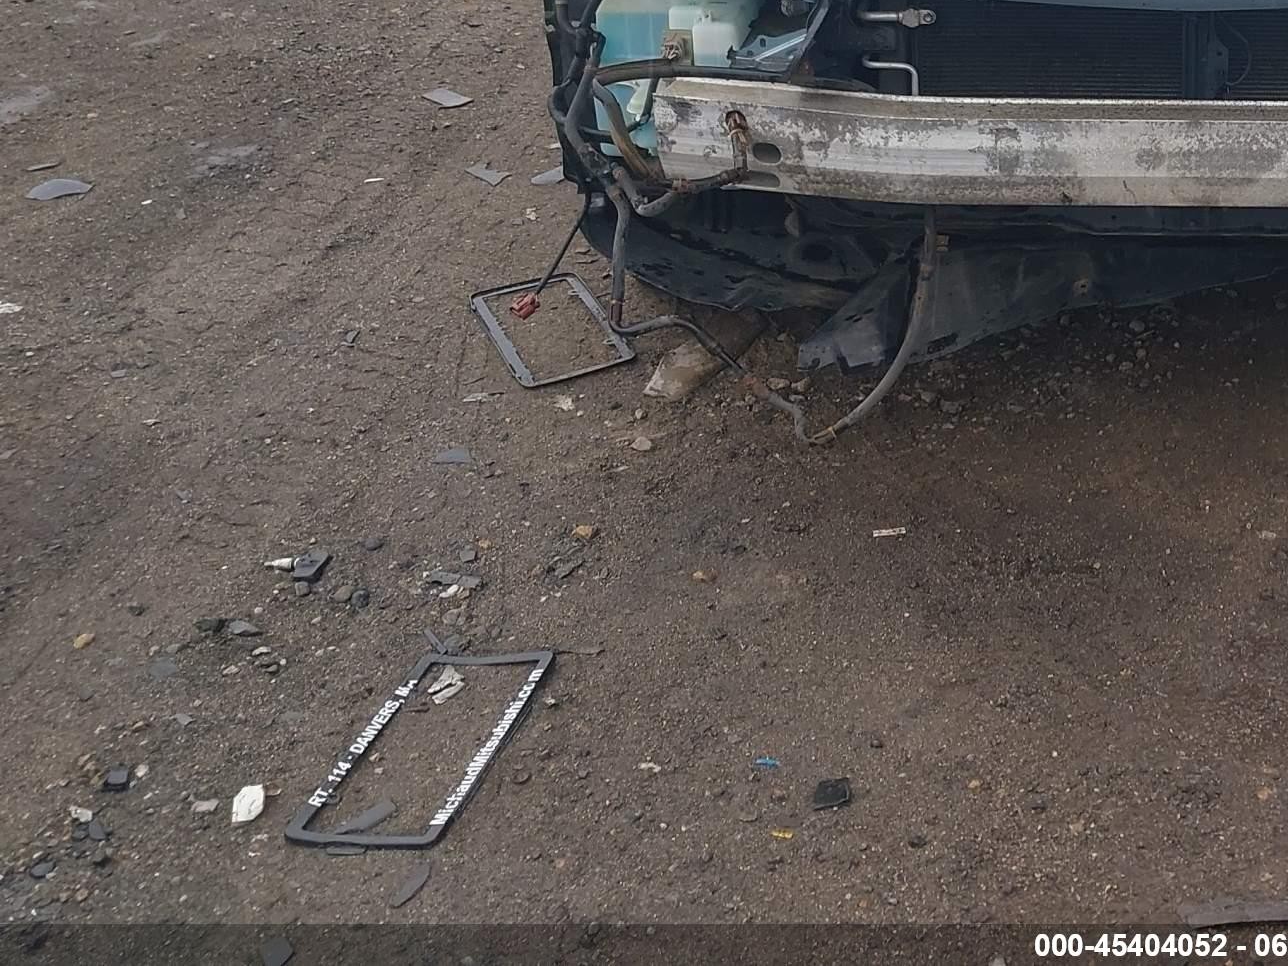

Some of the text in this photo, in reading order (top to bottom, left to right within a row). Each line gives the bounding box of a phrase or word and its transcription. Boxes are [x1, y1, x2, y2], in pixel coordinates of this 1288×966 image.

[308, 787, 333, 807] RT.
[327, 760, 352, 783] 114
[349, 698, 406, 754] DANVERS,
[429, 668, 544, 825] MichaudMitsubishi.com
